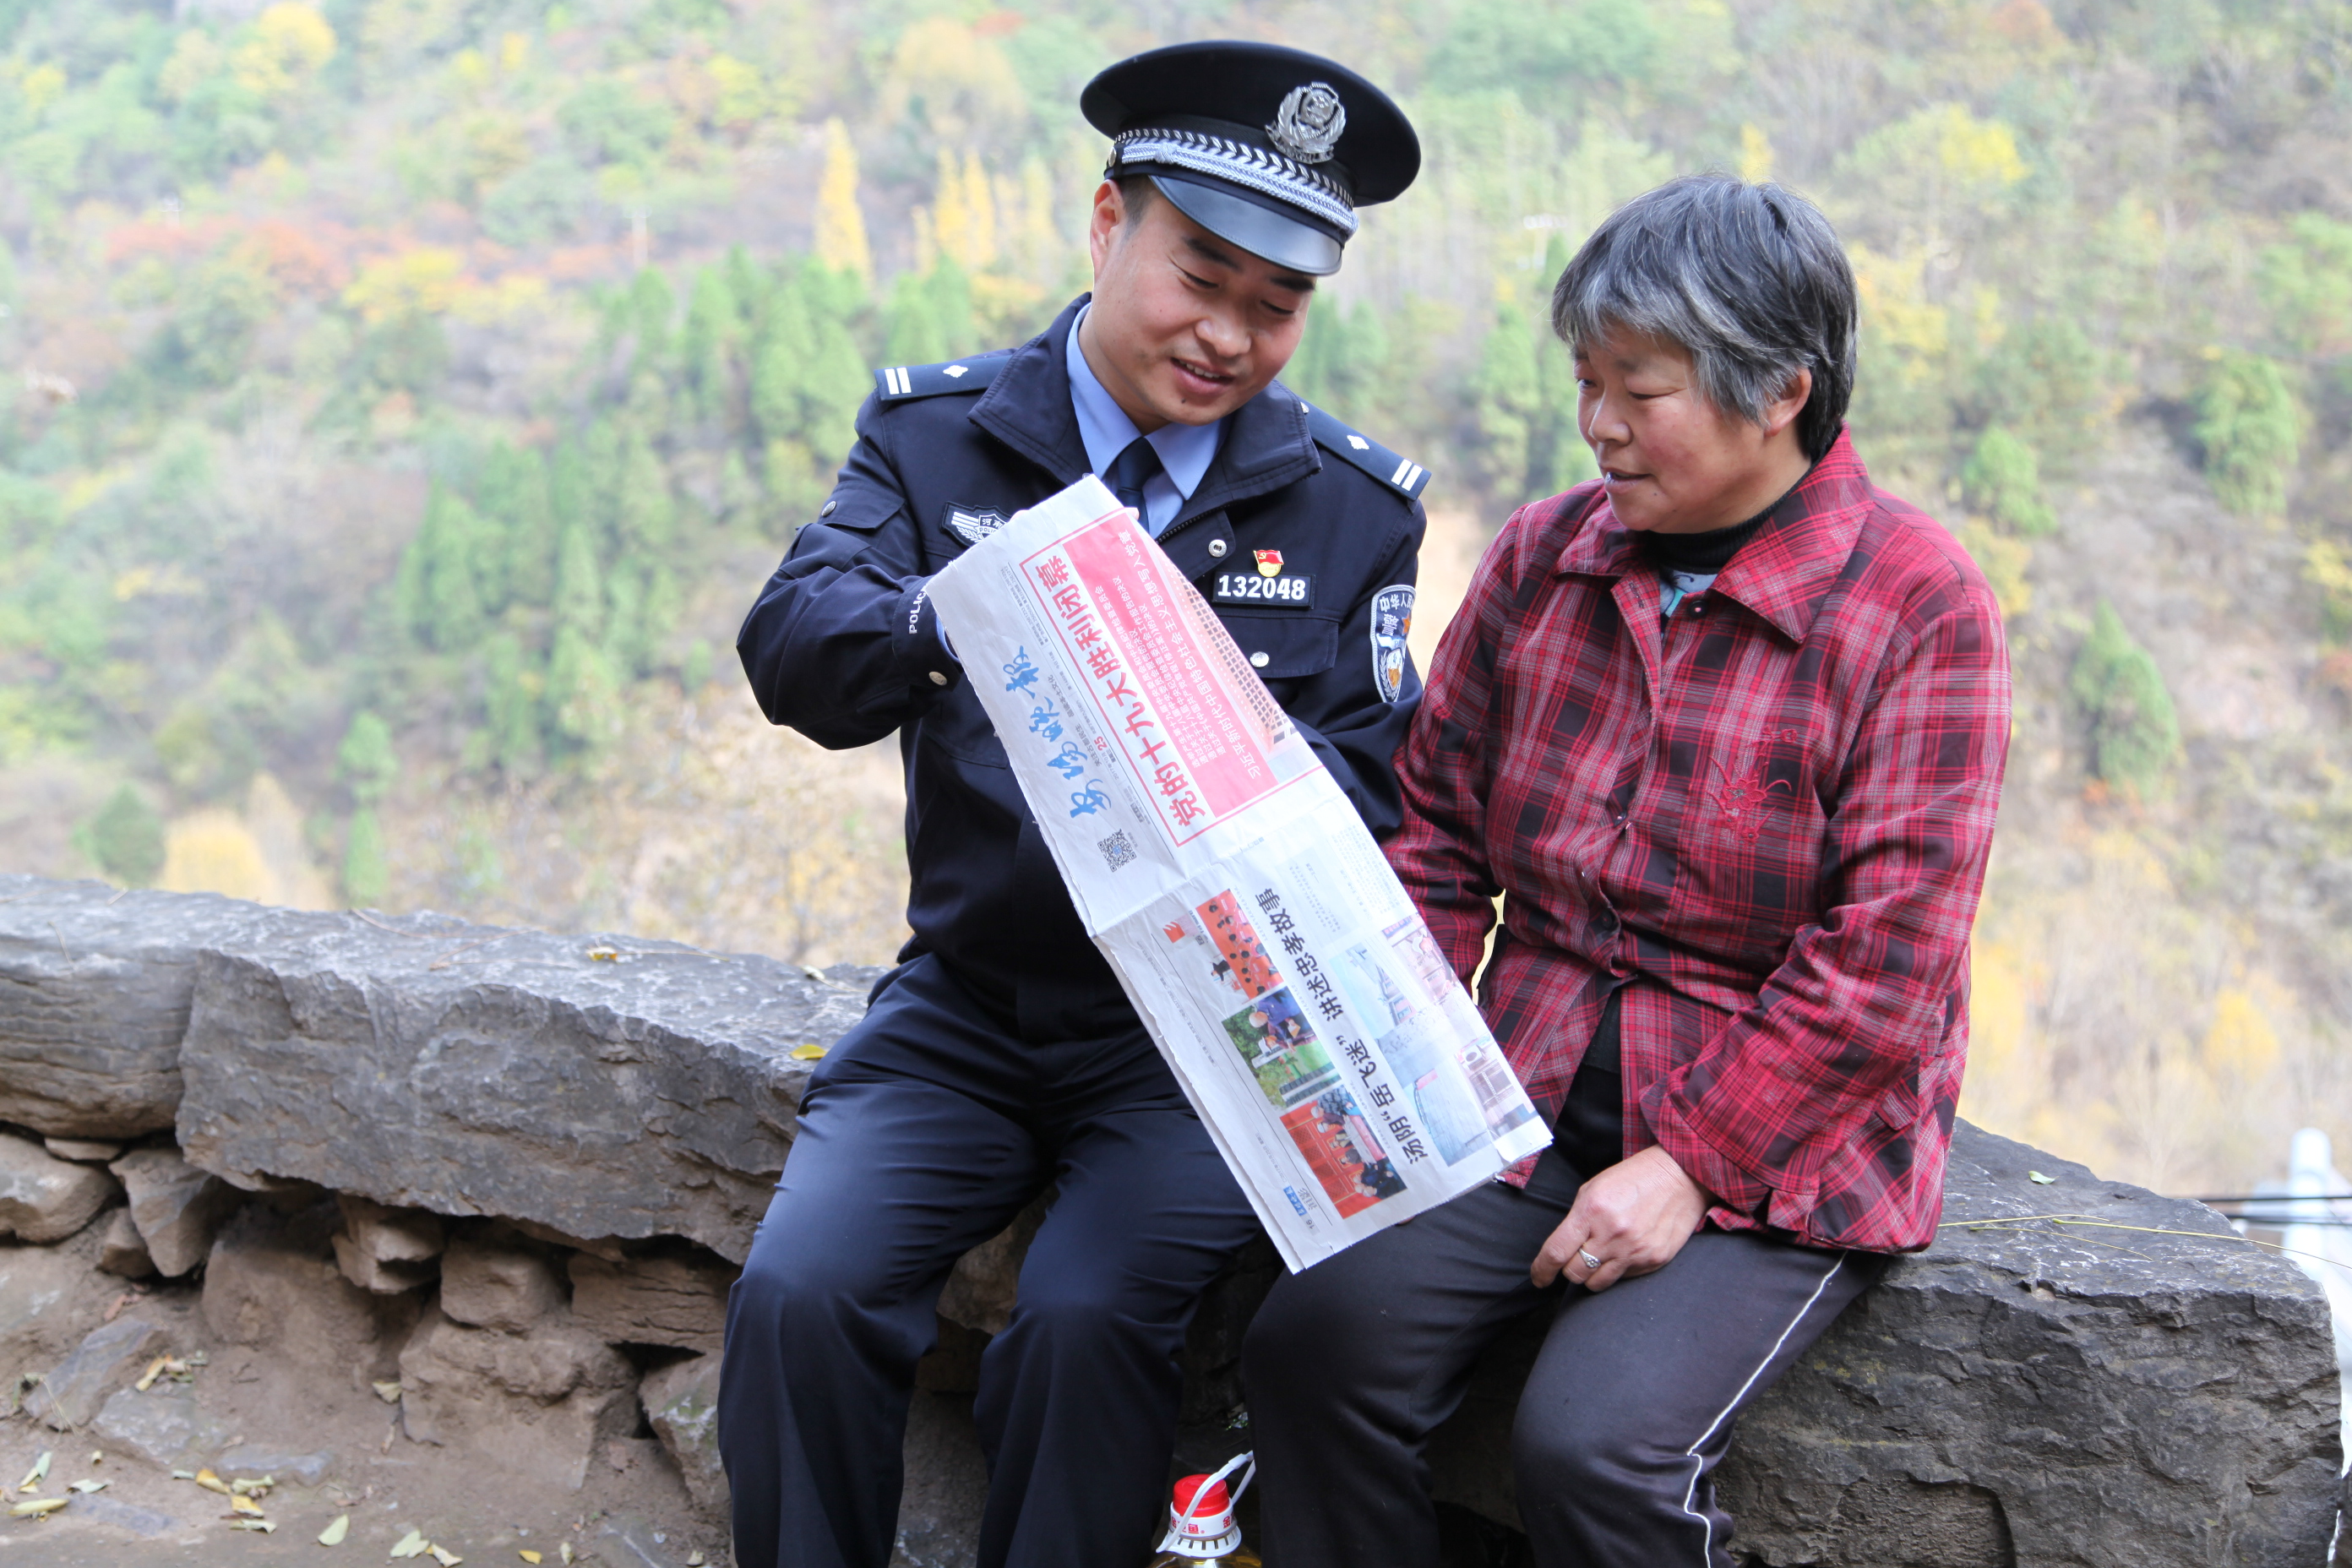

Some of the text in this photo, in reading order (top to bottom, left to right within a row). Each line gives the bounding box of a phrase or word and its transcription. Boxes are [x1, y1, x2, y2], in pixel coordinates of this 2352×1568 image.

[909, 592, 927, 634] POLIC
[1217, 575, 1306, 601] 132048
[1032, 552, 1208, 829] 党的十九大胜利闭幕
[1093, 584, 1200, 769] 选举产生第十九届中央委员会和中央纪律检查委员会
[1112, 574, 1217, 760] 通过关于十八届中央纪律检查委员会工作报告的决议
[1117, 528, 1262, 781] 习近平新时代中国特色社会主义思想写入党章
[1128, 628, 1209, 765] 通过关于十八届中央委员会报告的决议
[1046, 673, 1102, 766] 关注古都民生 品读本土文化
[1092, 735, 1108, 751] 25
[1253, 885, 1346, 1022] 讲述忠孝故事
[1305, 1218, 1315, 1229] 16
[1172, 1516, 1199, 1534] 金鱼
